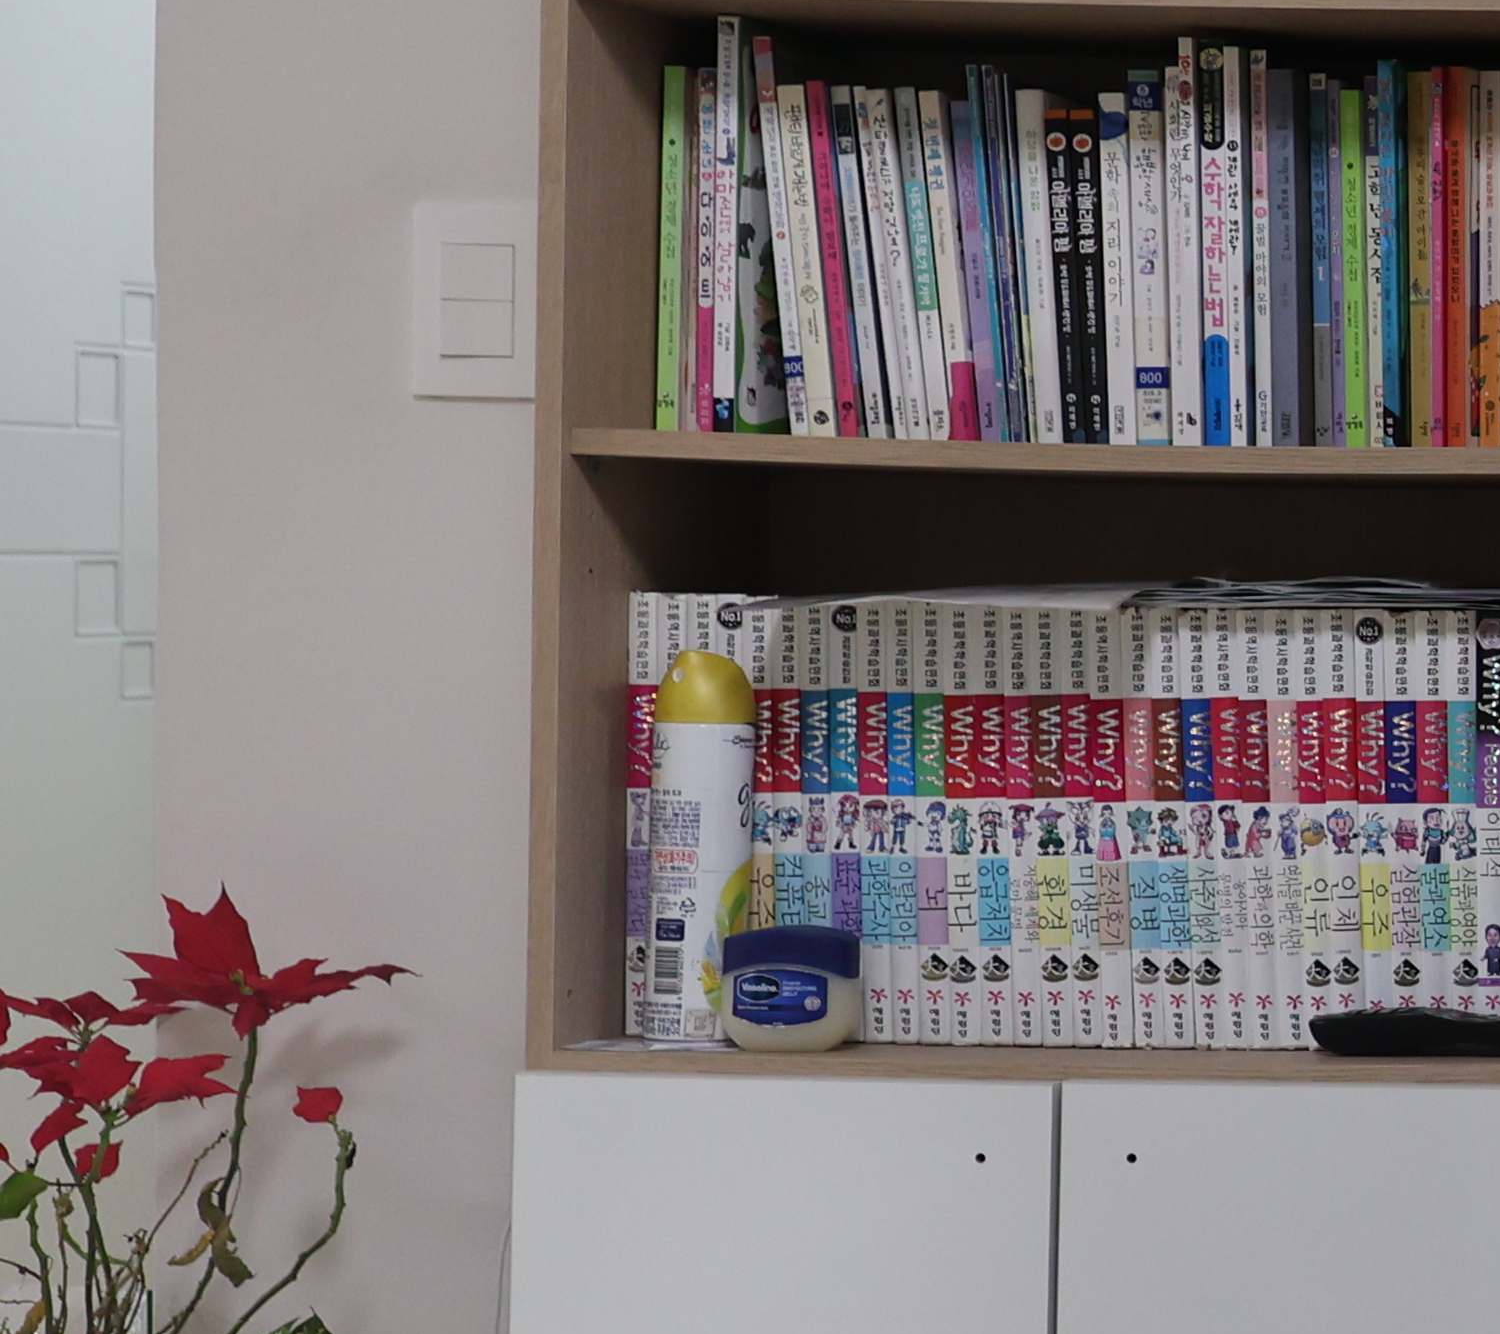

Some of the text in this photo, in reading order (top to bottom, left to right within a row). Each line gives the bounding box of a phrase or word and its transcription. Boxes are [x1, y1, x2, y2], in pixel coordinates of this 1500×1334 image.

[1131, 97, 1154, 108] 학년
[1104, 151, 1121, 185] 문학
[1105, 218, 1121, 253] 지리
[1203, 156, 1227, 327] 수학 잘하는 법
[1105, 258, 1124, 308] 이야기
[1139, 372, 1162, 384] 800
[774, 698, 800, 783] Why?
[802, 700, 829, 785] Why?
[861, 700, 887, 784] Why?
[946, 705, 976, 789] Why?
[978, 705, 1005, 788] Why?
[1034, 705, 1064, 788] Why?
[1065, 703, 1093, 787] Why?
[1094, 708, 1121, 793] Why?
[1155, 709, 1182, 791] Why?
[1327, 708, 1355, 790] Why?
[1358, 709, 1385, 796] Why?
[1388, 712, 1416, 793] Why?
[804, 875, 830, 922] 종교
[832, 855, 861, 897] 표준
[862, 861, 890, 942] 과학수사
[890, 862, 917, 942] 이탈리아
[918, 887, 947, 911] 뇌
[948, 872, 978, 932] 바다
[979, 860, 1010, 943] 응급처치
[1038, 873, 1067, 931] 환경
[1071, 863, 1098, 940] 미생물
[1099, 869, 1124, 947] 조선후기
[1130, 875, 1159, 932] 질병
[1159, 865, 1190, 947] 생명과학
[1277, 864, 1303, 949] 역사를 바꾼 사건
[1304, 878, 1331, 935] 인류
[1331, 875, 1359, 934] 인체
[1361, 876, 1389, 937] 우주
[1391, 866, 1420, 948] 실험관찰
[1422, 867, 1450, 948] 불과 연소
[741, 980, 779, 994] Vaseline
